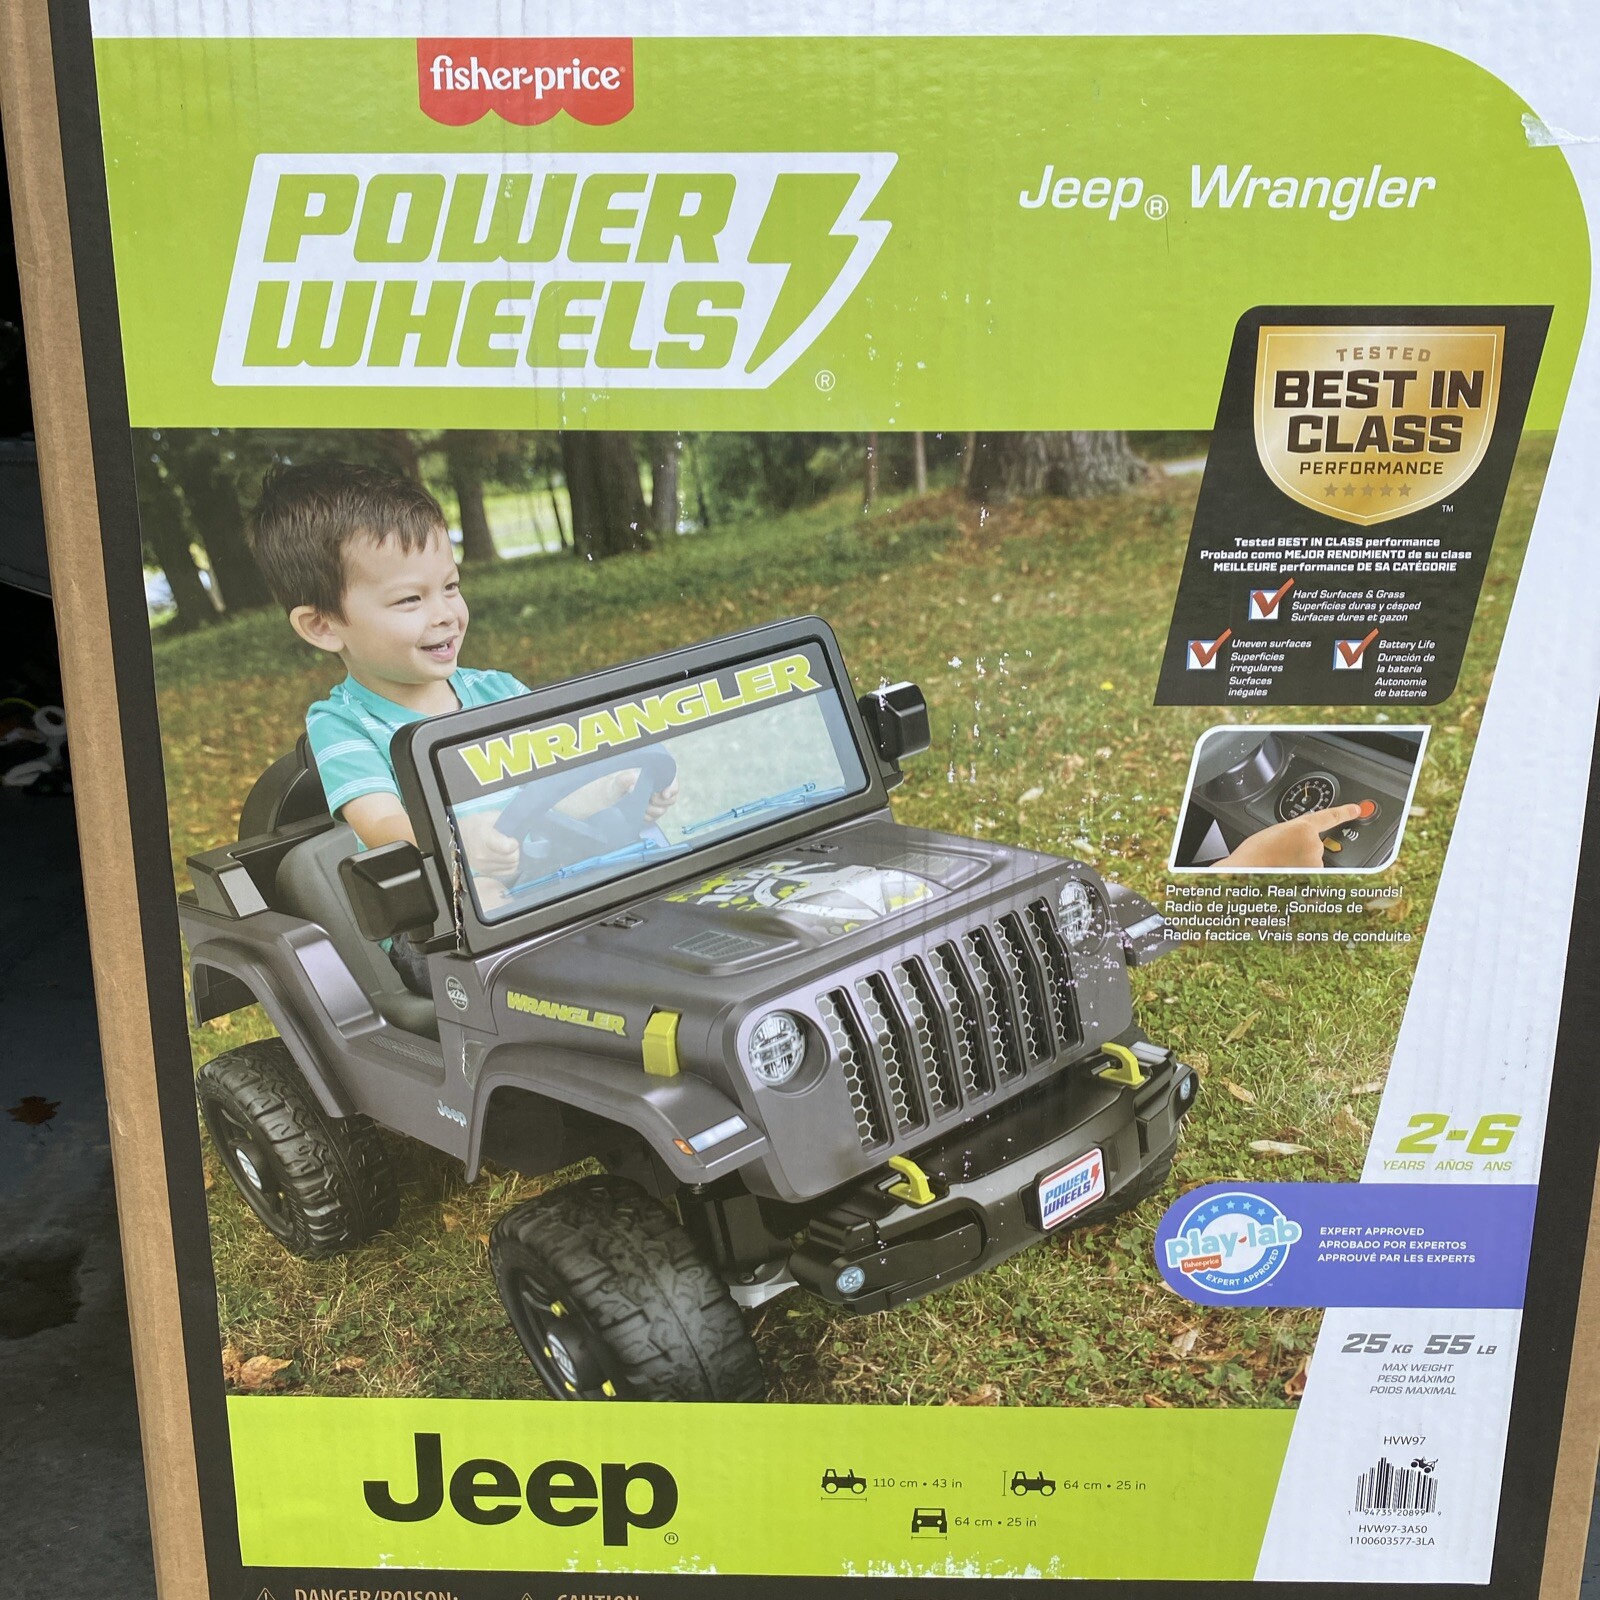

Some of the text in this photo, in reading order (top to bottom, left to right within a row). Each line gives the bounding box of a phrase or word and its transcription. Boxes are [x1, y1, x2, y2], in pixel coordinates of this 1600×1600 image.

[1189, 165, 1436, 221] Wrangler
[262, 174, 736, 262] POWER
[242, 280, 746, 369] WHEELS
[1336, 346, 1431, 362] TESTED
[1274, 370, 1484, 408] BEST IN
[1287, 415, 1463, 454] CLASS
[1300, 461, 1443, 475] PERFORMANCE
[1235, 538, 1440, 549] Tested BEST IN CLASS performance
[1200, 550, 1248, 560] Probado
[1285, 550, 1325, 559] MEJOR
[1327, 550, 1405, 559] RENDIMIENTO
[1408, 550, 1422, 559] de
[1441, 550, 1472, 560] clase
[1214, 560, 1456, 573] MEILLEURE performance DE SA CATÉGORIE
[1293, 590, 1405, 599] Hard Surfaces & Grass
[1292, 601, 1421, 612] Superficies duras y césped
[1291, 613, 1408, 623] Surfaces dures et gazon
[1232, 640, 1311, 648] Uneven surfaces
[1379, 640, 1435, 651] Battery Life
[1231, 652, 1284, 663] Superficies
[1378, 653, 1435, 662] Duración de
[1230, 664, 1283, 674] irregulares
[1377, 664, 1422, 673] la batería
[1229, 677, 1272, 685] Surfaces
[1375, 678, 1426, 686] Autonomie
[1229, 687, 1267, 698] inégales
[1375, 688, 1427, 697] de batterie
[457, 653, 822, 786] WRANGLER
[1166, 885, 1403, 900] Pretend radio. Real driving sounds!
[1166, 901, 1203, 912] Radio
[1207, 902, 1223, 912] de
[1227, 902, 1280, 916] juguete.
[1346, 902, 1362, 913] de
[1164, 914, 1290, 926] conducción reales!
[1164, 930, 1411, 942] Radio factice. Vrais sons de conduite
[507, 991, 626, 1036] WRANGLER
[437, 1100, 467, 1128] Jeep
[1396, 1113, 1522, 1155] 2-6
[1383, 1159, 1511, 1171] YEARS AÑOS ANS
[1045, 1169, 1089, 1203] POWER
[1044, 1180, 1091, 1216] WHEELS
[1320, 1227, 1424, 1236] EXPERT APPROVED
[1319, 1240, 1466, 1249] APROBADO POR EXPERTOS
[1317, 1252, 1475, 1263] APPROUVÉ PAR LES EXPERTS
[1206, 1249, 1279, 1285] EXPERT APPROVED
[1341, 1334, 1497, 1355] 25 KG 55 LB
[1410, 1364, 1453, 1372] WEIGHT
[1377, 1373, 1455, 1383] PESO MÁXIMO
[1405, 1387, 1456, 1395] MAXIMAL
[1384, 1437, 1426, 1445] HVW97
[874, 1478, 895, 1488] 110
[900, 1480, 918, 1488] cm
[933, 1479, 947, 1488] 43
[952, 1479, 962, 1488] in
[1064, 1481, 1079, 1490] 64
[1084, 1482, 1102, 1490] cm
[1117, 1481, 1131, 1490] 25
[1136, 1481, 1145, 1490] in
[955, 1517, 970, 1526] 64
[975, 1518, 993, 1526] cm
[1007, 1518, 1021, 1526] 25
[1026, 1518, 1036, 1526] in
[1359, 1525, 1427, 1533] HVW97-3A50
[1350, 1537, 1434, 1545] 1100603577-3LA
